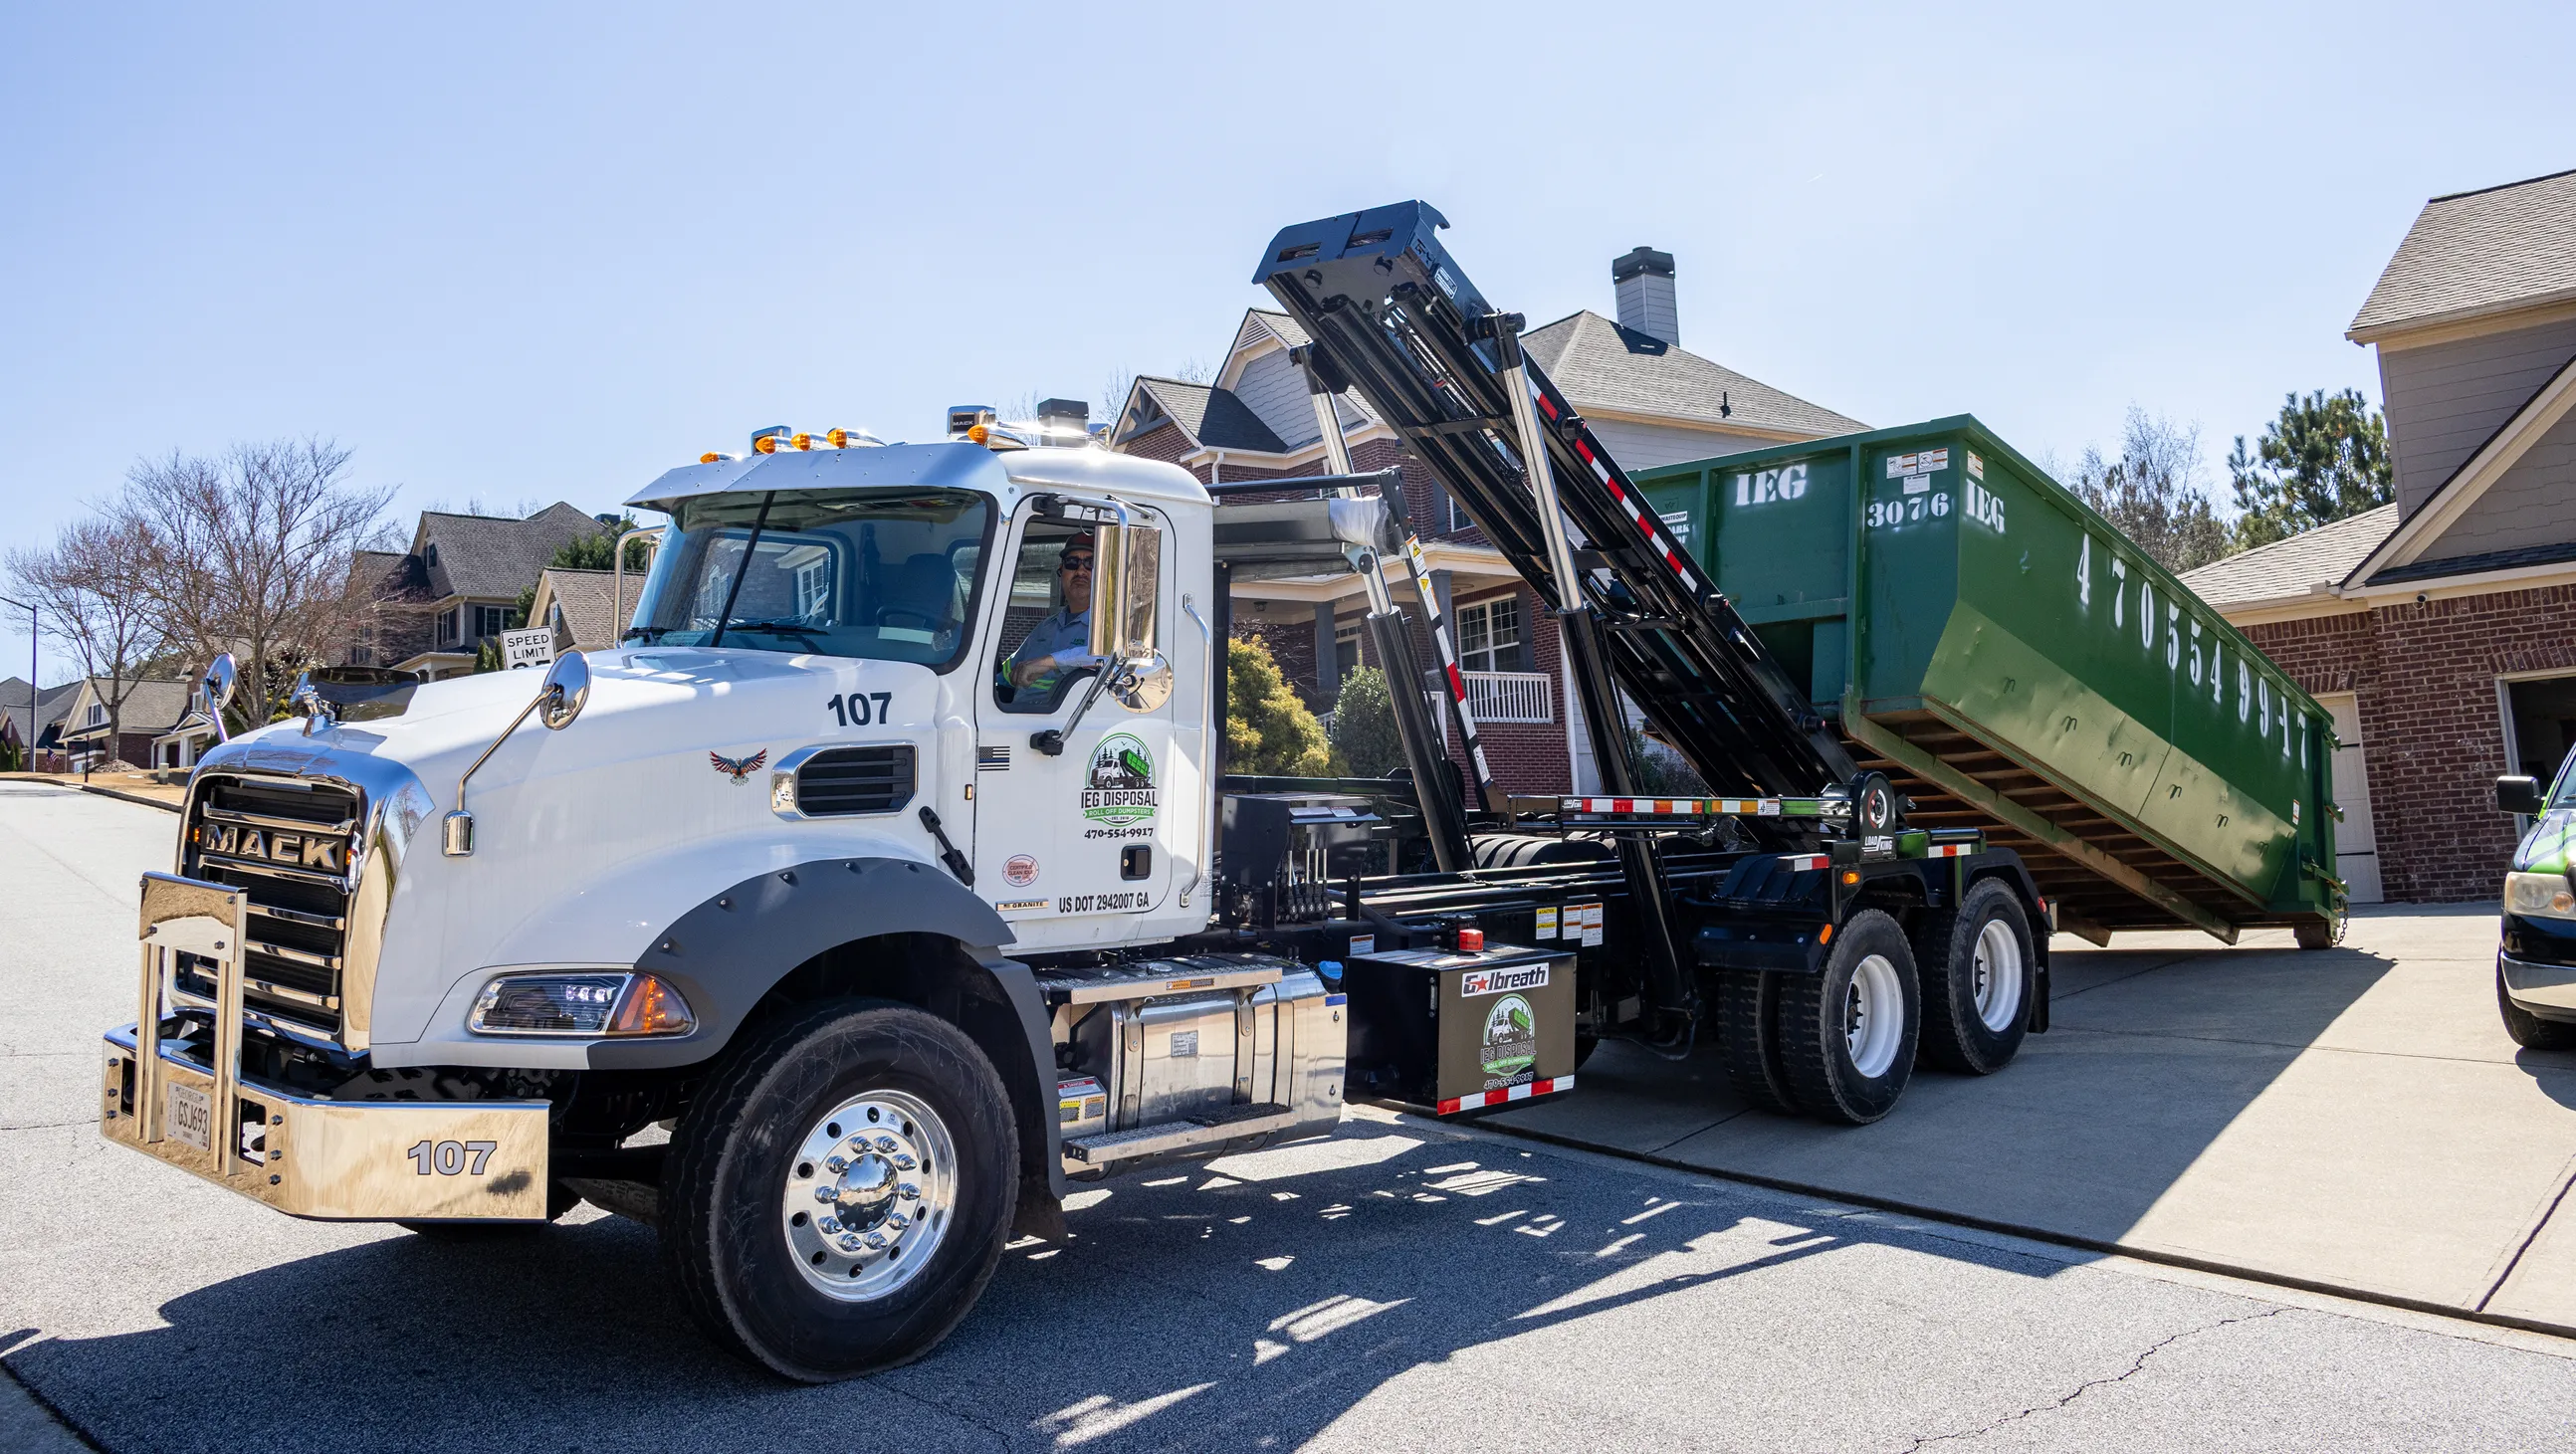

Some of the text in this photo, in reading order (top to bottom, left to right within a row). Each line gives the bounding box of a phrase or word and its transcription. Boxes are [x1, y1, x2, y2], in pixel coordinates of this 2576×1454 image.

[1735, 464, 1808, 506] IEG
[1867, 493, 1949, 527] 3076
[1966, 478, 2006, 533] IEG
[1668, 523, 1689, 533] ARK
[507, 634, 549, 647] SPEED
[513, 647, 546, 659] LIMIT
[827, 692, 893, 727] 107
[1081, 790, 1158, 809] IEG DISPOSAL
[205, 824, 339, 869] MACK
[1084, 827, 1154, 839] 470-554-9917
[1058, 892, 1150, 913] US DOT 2942007 GA
[1480, 1040, 1537, 1065] IEG DISPOSAL
[178, 1101, 208, 1135] GSJ693
[407, 1140, 498, 1175] 107
